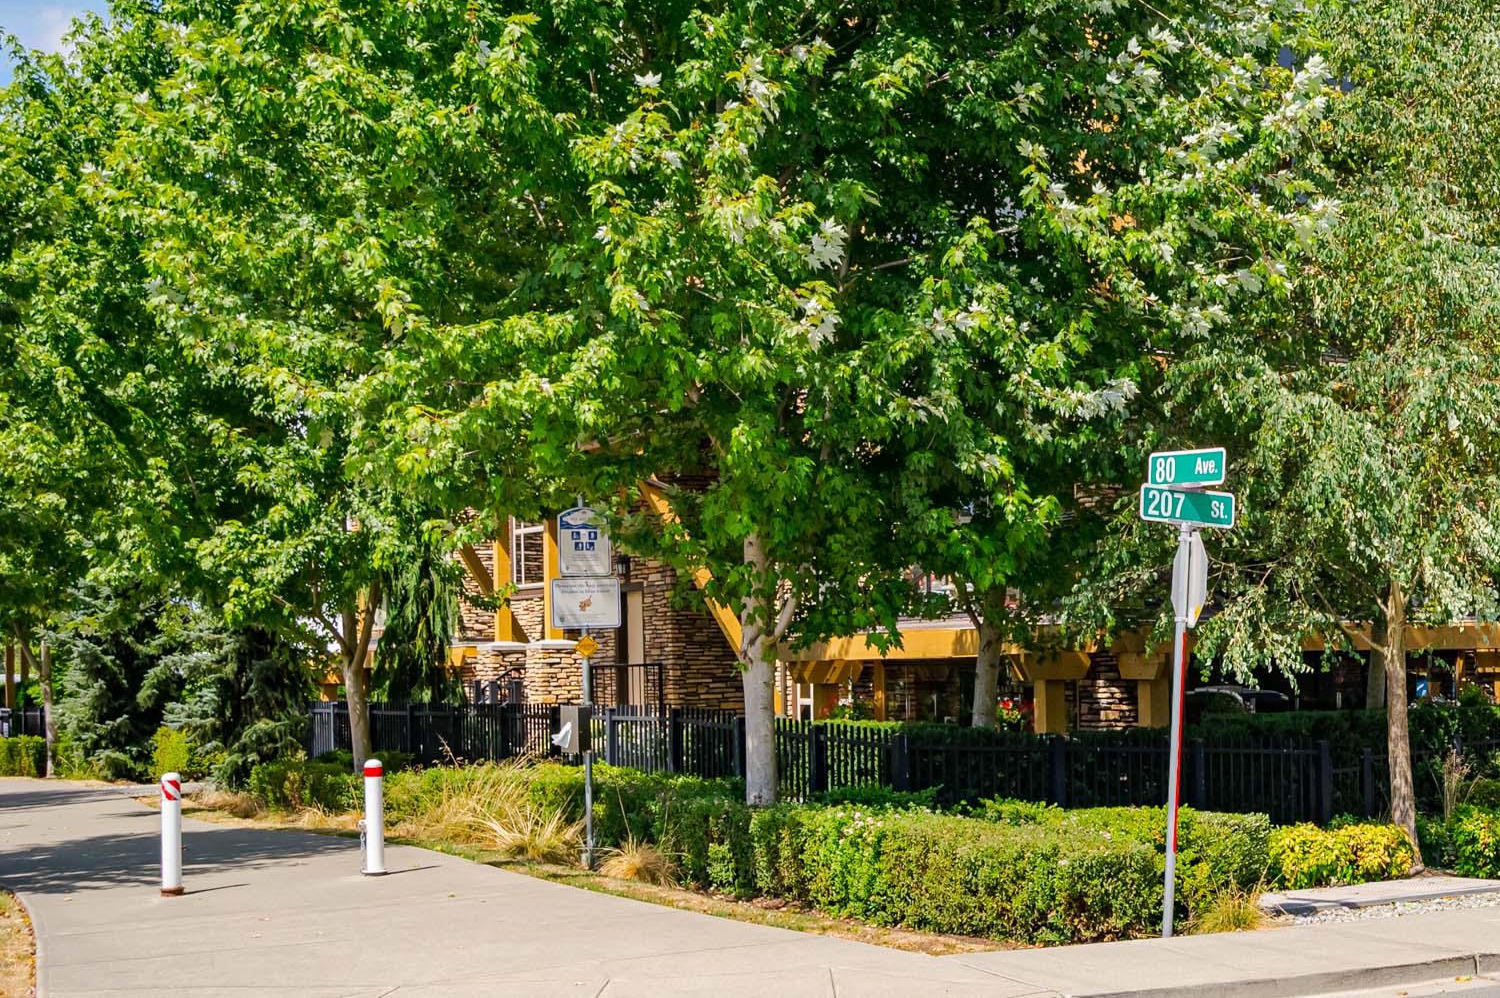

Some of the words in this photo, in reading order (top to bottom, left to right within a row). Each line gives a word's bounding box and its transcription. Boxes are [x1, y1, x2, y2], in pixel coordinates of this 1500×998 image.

[1155, 457, 1176, 483] 80
[1195, 457, 1219, 475] Ave.
[1147, 490, 1186, 518] 207
[1210, 500, 1228, 519] St.
